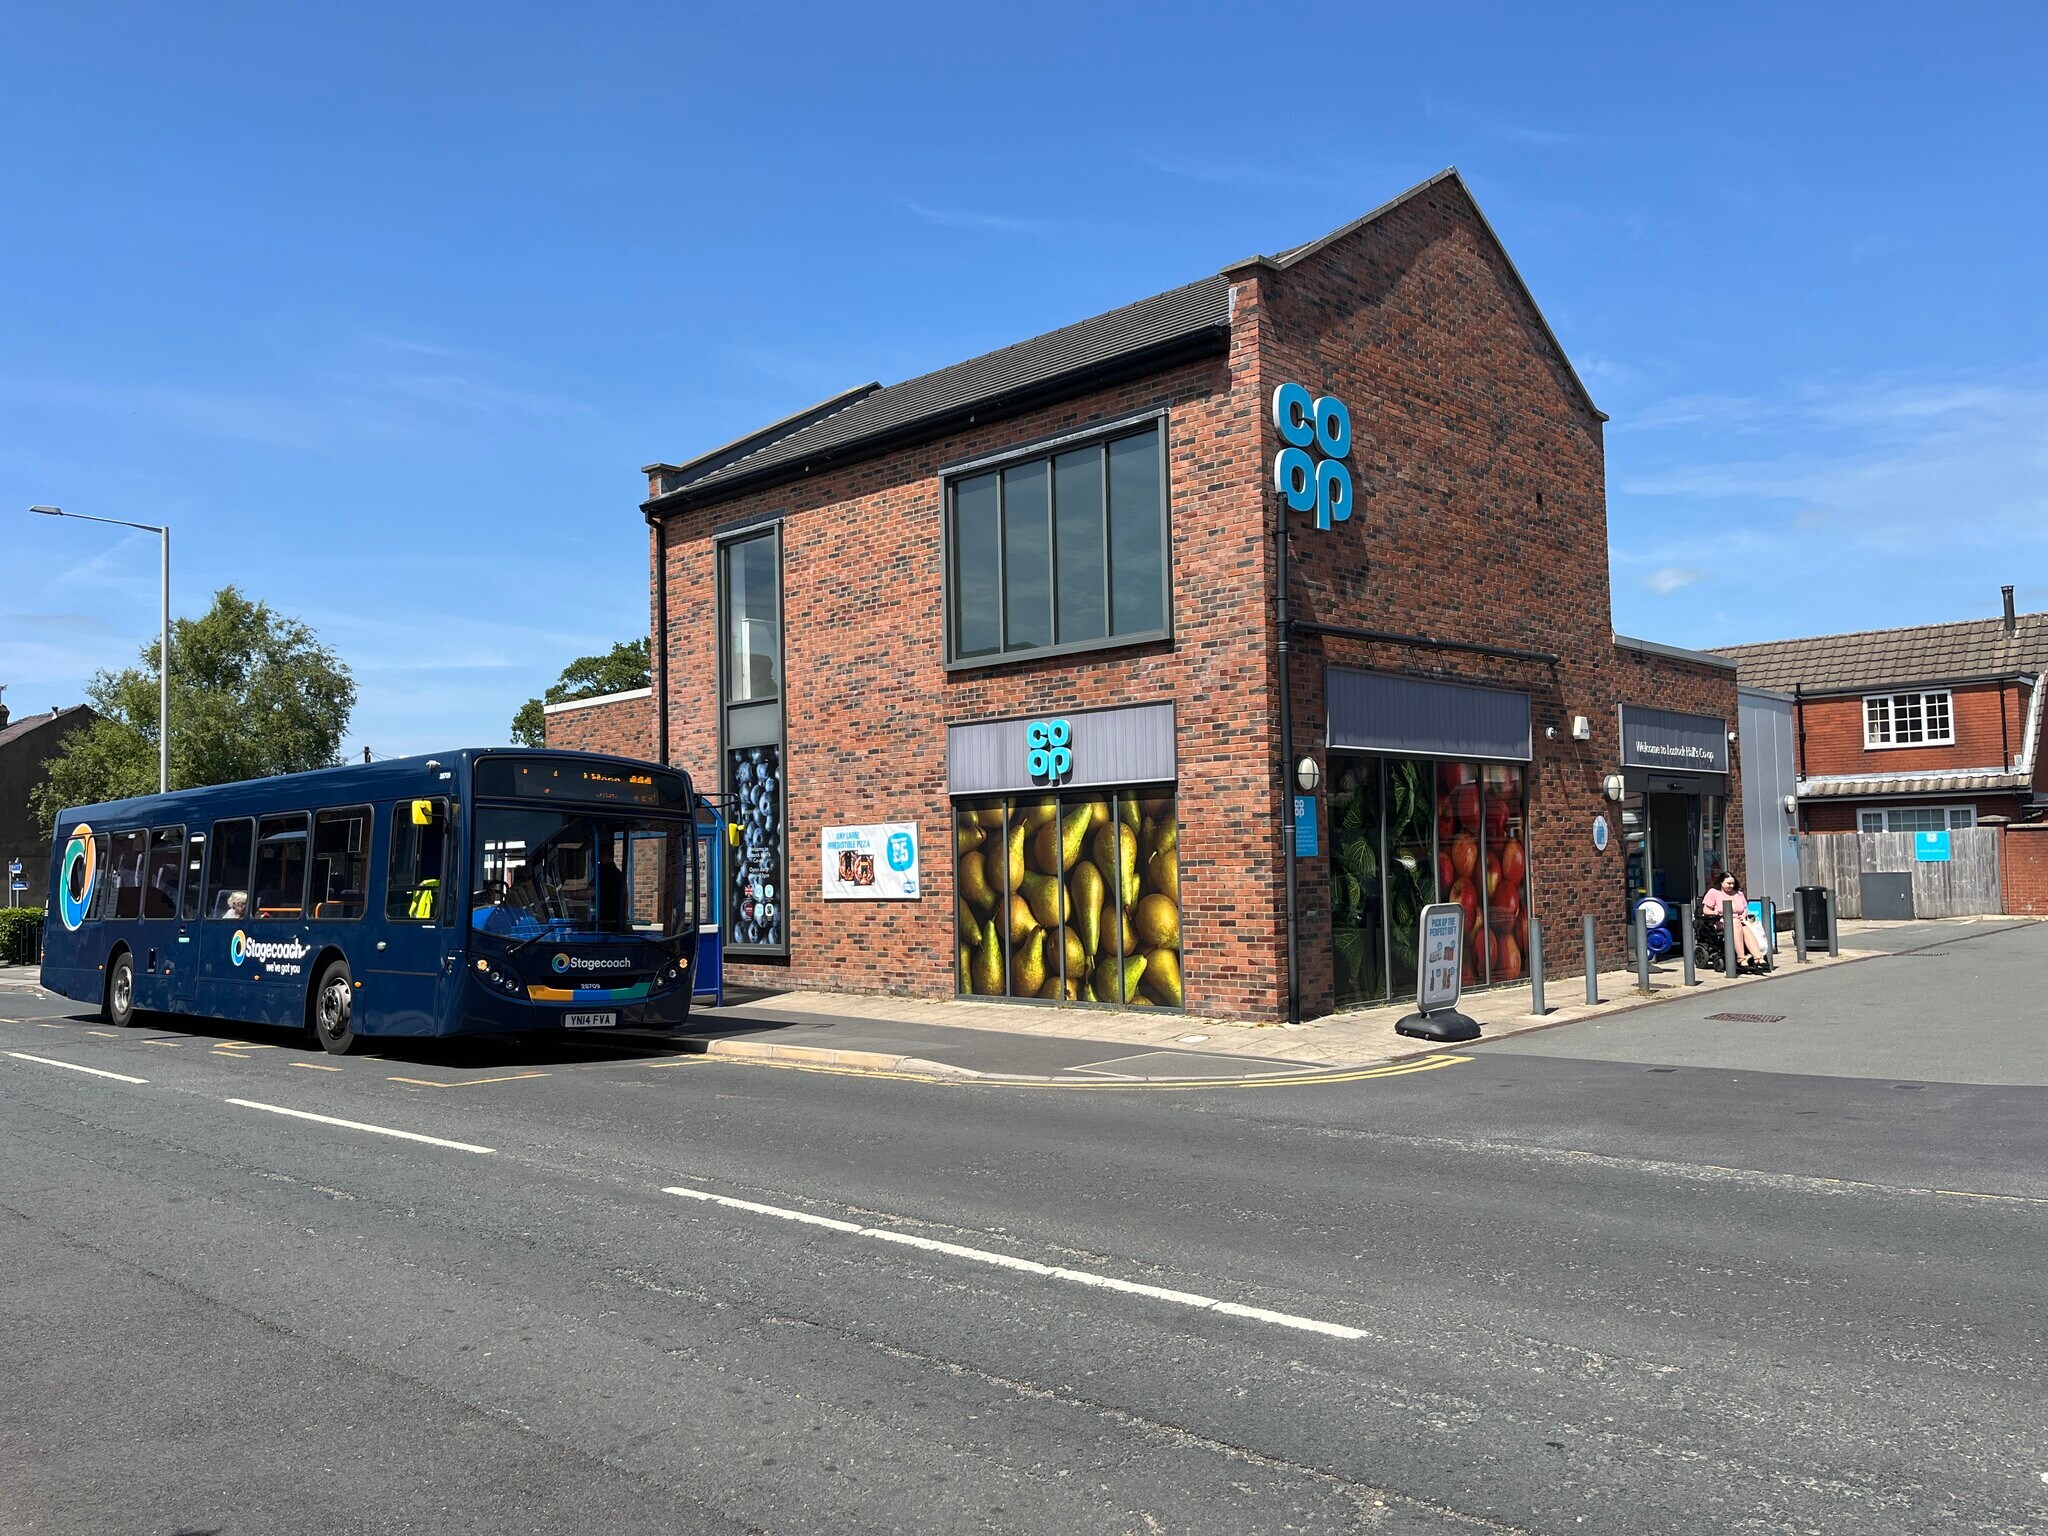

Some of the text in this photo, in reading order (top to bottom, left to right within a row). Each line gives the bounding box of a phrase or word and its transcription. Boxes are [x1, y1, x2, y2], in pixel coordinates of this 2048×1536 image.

[1635, 741, 1660, 754] Welcome
[1660, 745, 1666, 755] to
[1666, 744, 1685, 757] Lostock
[836, 832, 846, 840] ANY
[828, 840, 870, 850] IRRESISTIBLE PIZZA
[1432, 919, 1441, 928] PICK
[1430, 927, 1447, 937] PERFECT
[246, 937, 302, 963] Stagecoach
[266, 961, 300, 975] we've got you
[570, 957, 631, 970] Stagecoach
[570, 1014, 611, 1026] YN14 FVA
